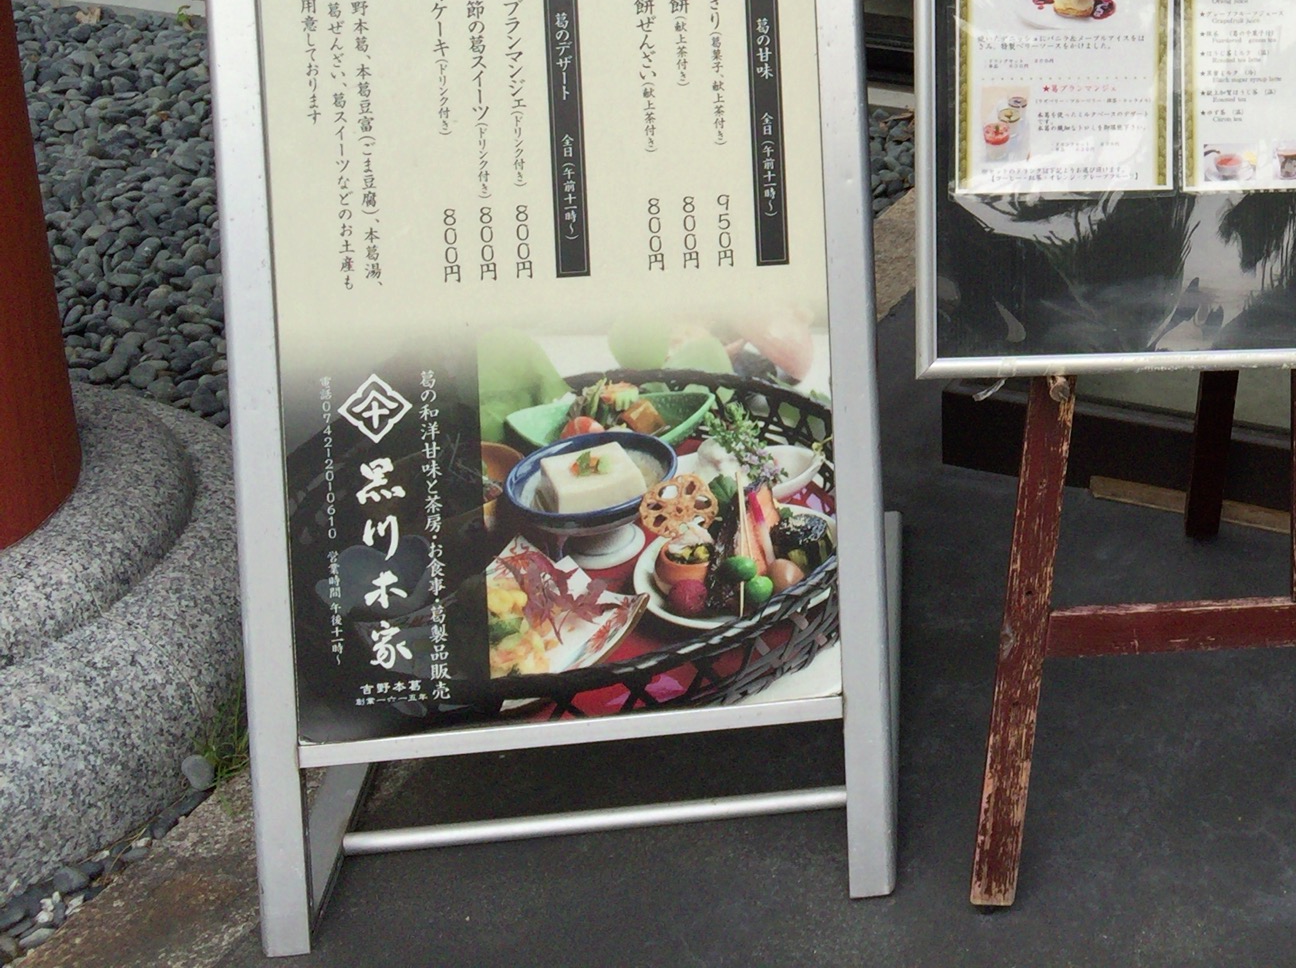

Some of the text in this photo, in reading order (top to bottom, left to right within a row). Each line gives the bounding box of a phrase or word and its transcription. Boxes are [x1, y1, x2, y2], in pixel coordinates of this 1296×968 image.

[554, 11, 573, 101] 葛のデザート
[755, 16, 774, 80] 葛の甘味
[442, 207, 462, 284] 800円
[479, 206, 498, 282] 800円
[514, 204, 534, 280] 800円
[647, 197, 666, 272] 800円
[682, 195, 700, 270] 800円
[716, 193, 735, 268] 950円
[355, 457, 413, 670] 黒川本家
[360, 679, 422, 696] 吉野本葛
